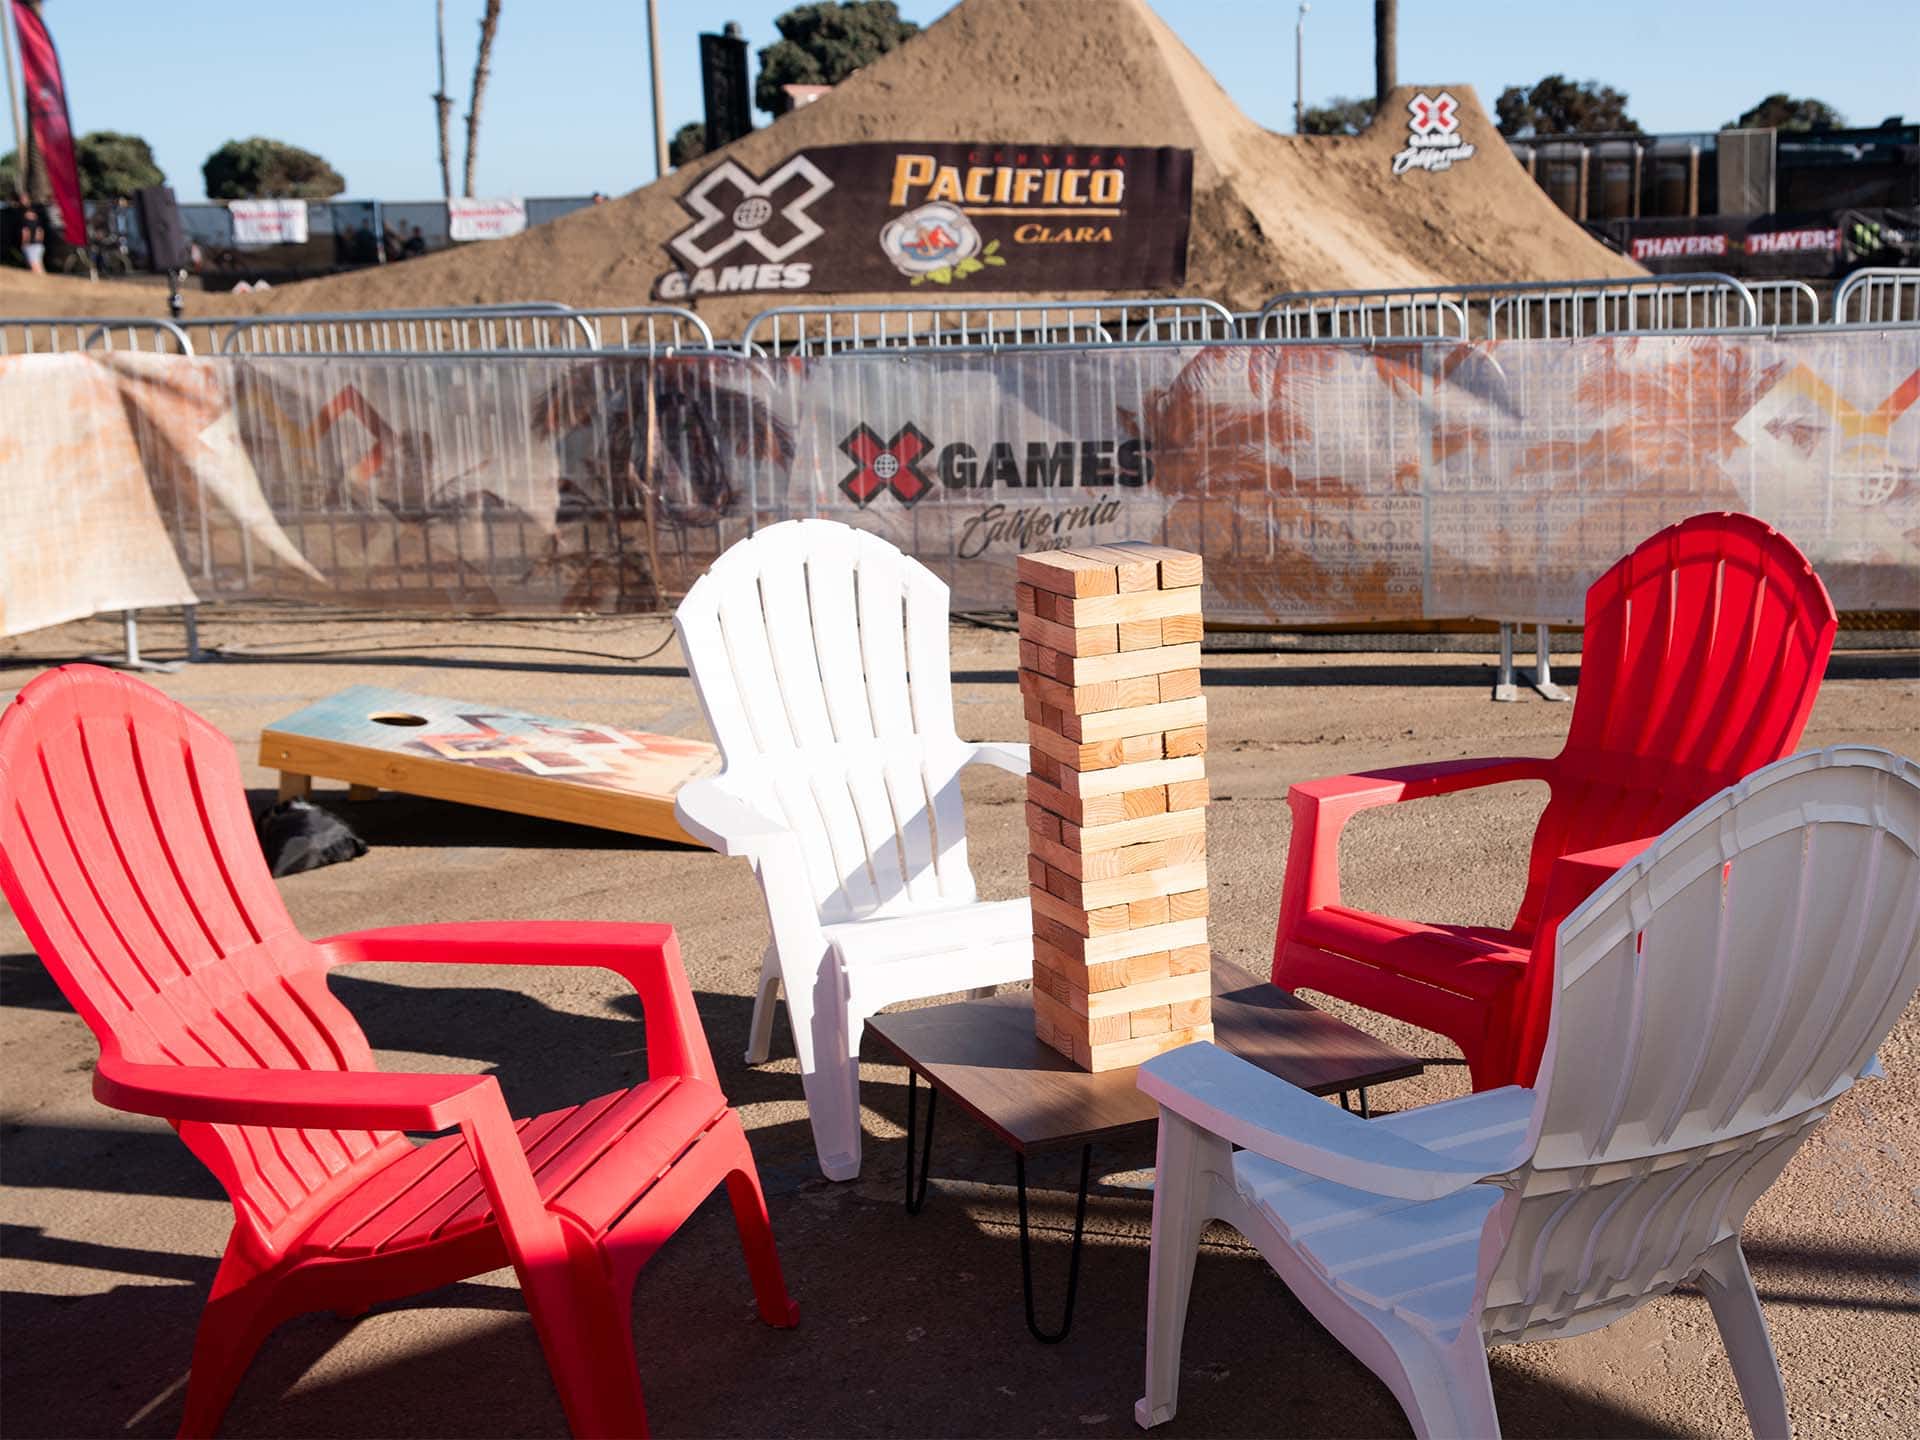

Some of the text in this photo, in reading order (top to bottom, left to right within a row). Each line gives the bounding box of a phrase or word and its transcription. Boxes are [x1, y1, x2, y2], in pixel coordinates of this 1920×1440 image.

[1013, 223, 1114, 244] CLARA
[1634, 234, 1726, 257] THAYERS
[1750, 229, 1838, 252] THAYERS
[658, 262, 814, 299] GAMES
[937, 440, 1155, 489] GAMES
[958, 494, 1121, 559] California
